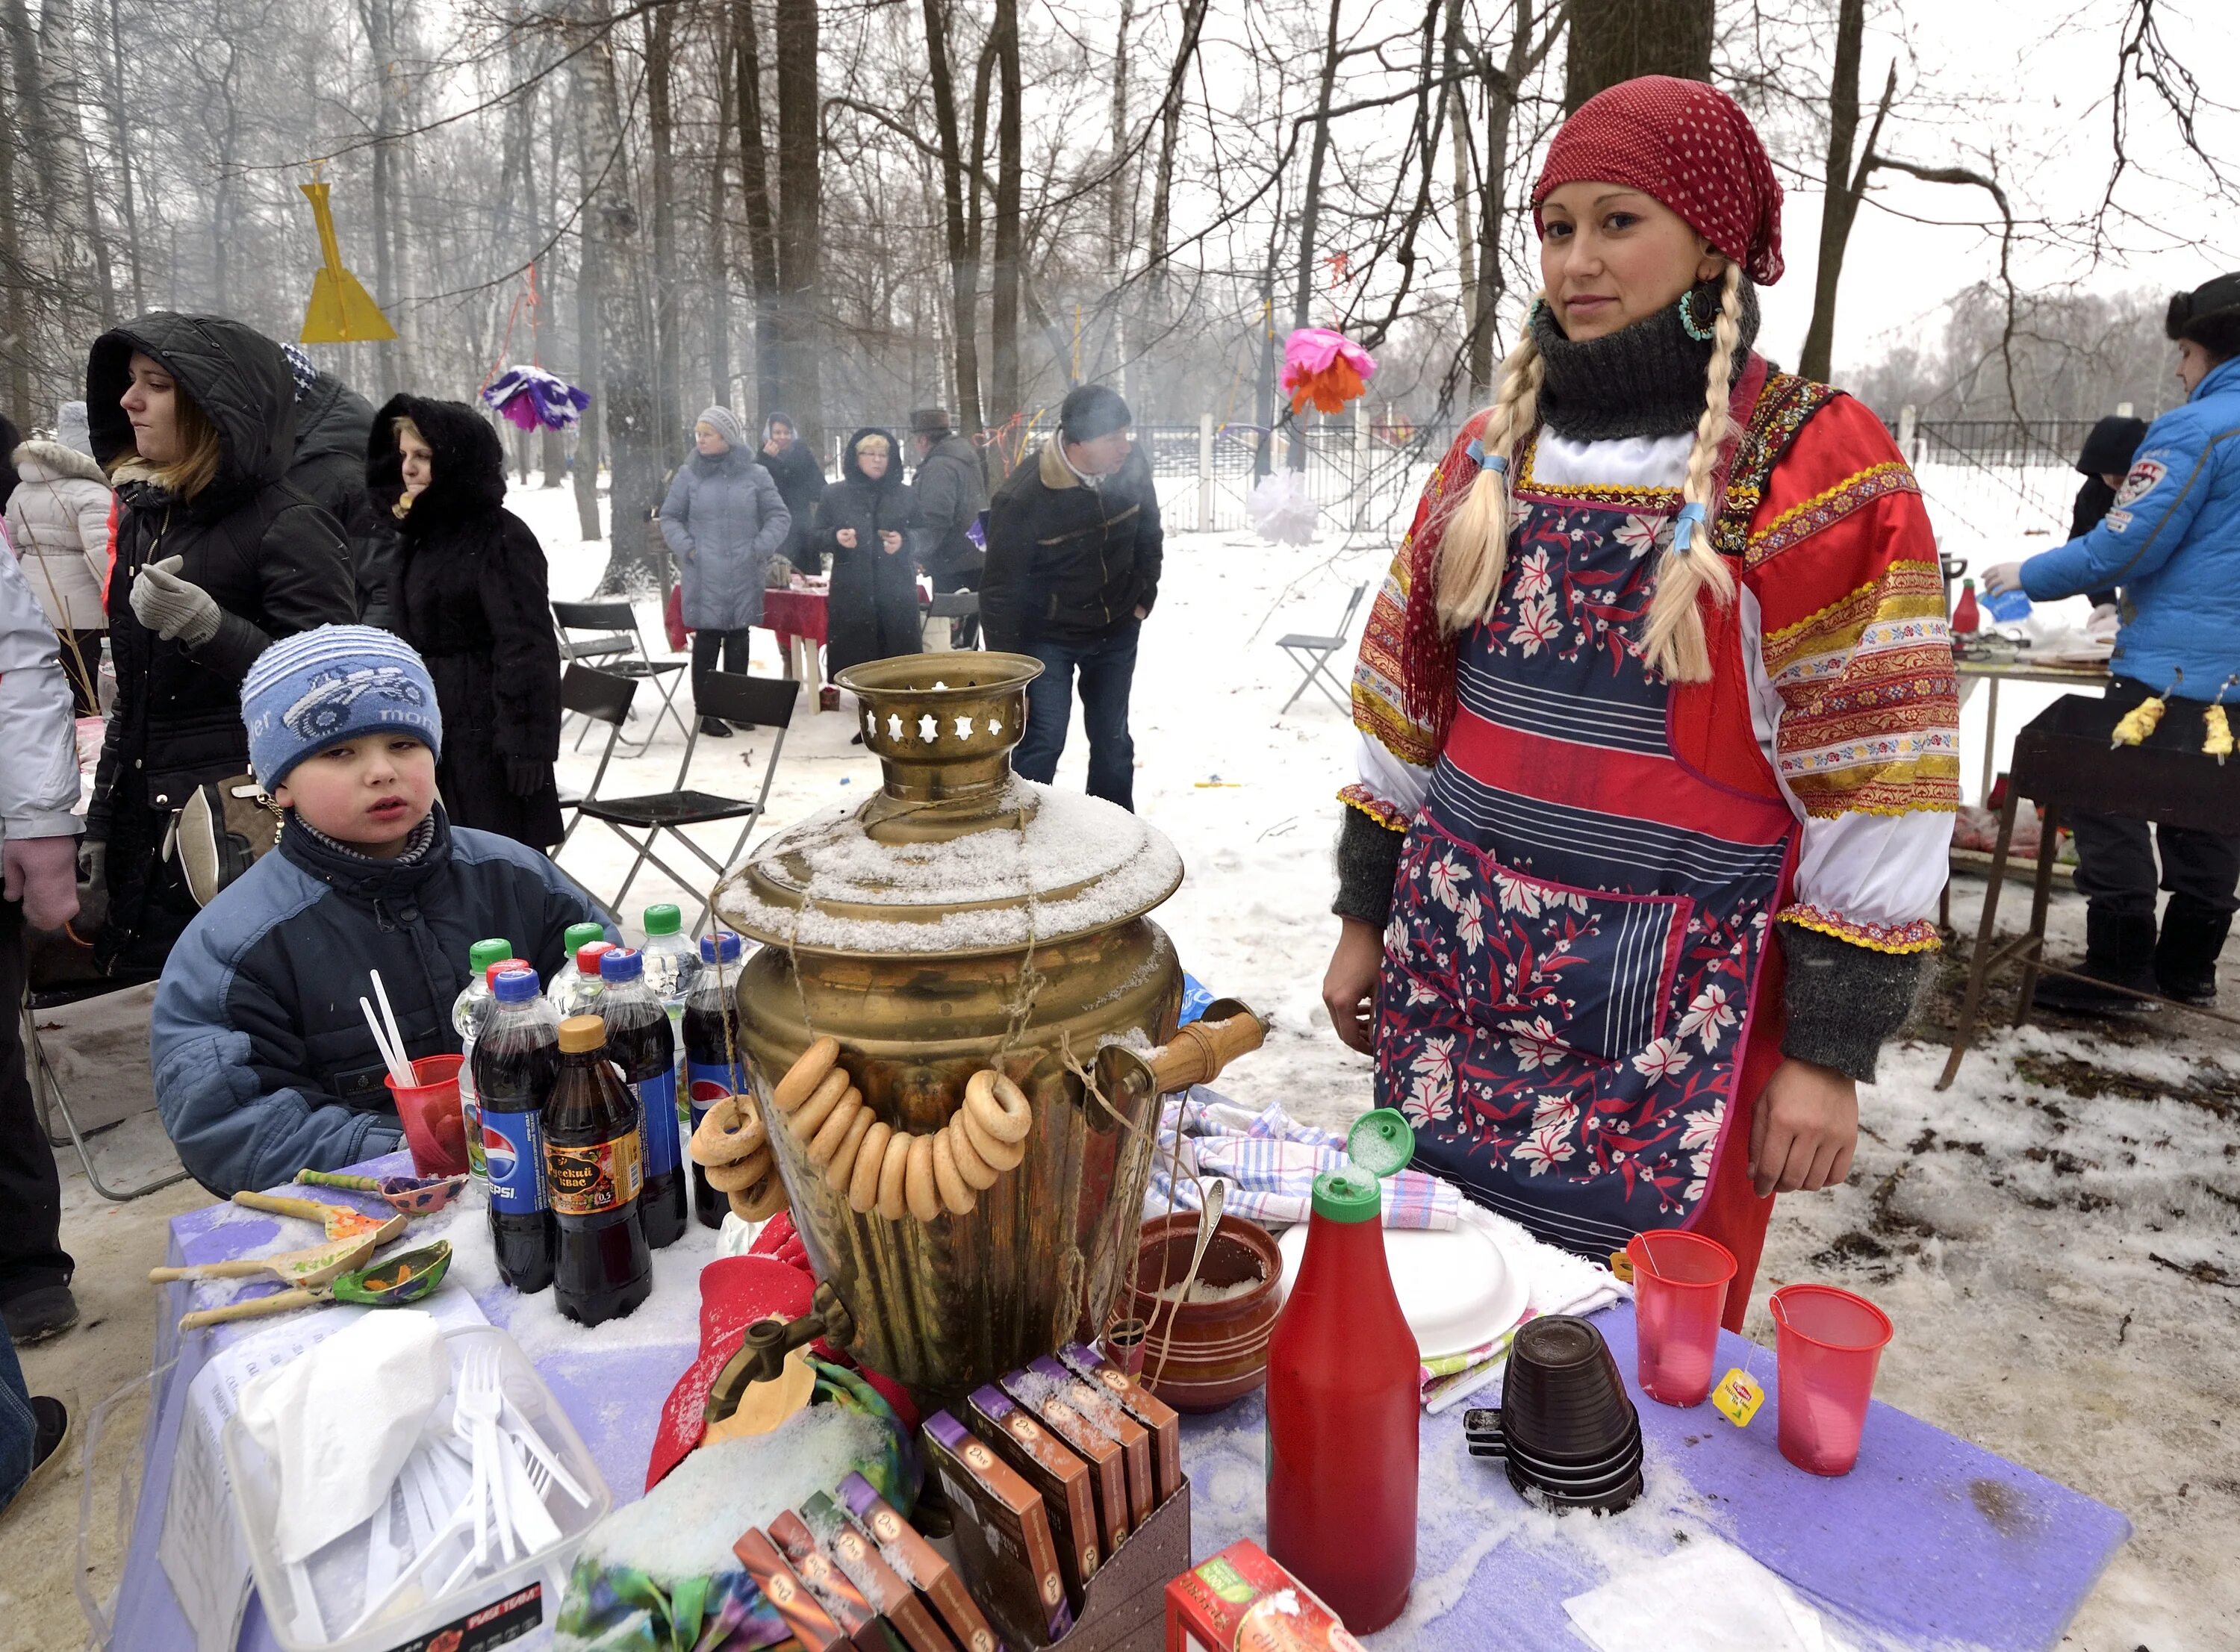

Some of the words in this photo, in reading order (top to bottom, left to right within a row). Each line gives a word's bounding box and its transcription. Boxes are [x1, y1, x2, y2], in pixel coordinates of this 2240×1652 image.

[547, 1161, 593, 1179] Русский
[489, 1182, 515, 1199] EPSI
[559, 1177, 587, 1188] квас
[1105, 1371, 1126, 1389] Dove
[1015, 1418, 1036, 1438] Dove
[968, 1447, 989, 1466] Dove
[877, 1514, 897, 1536] Dove
